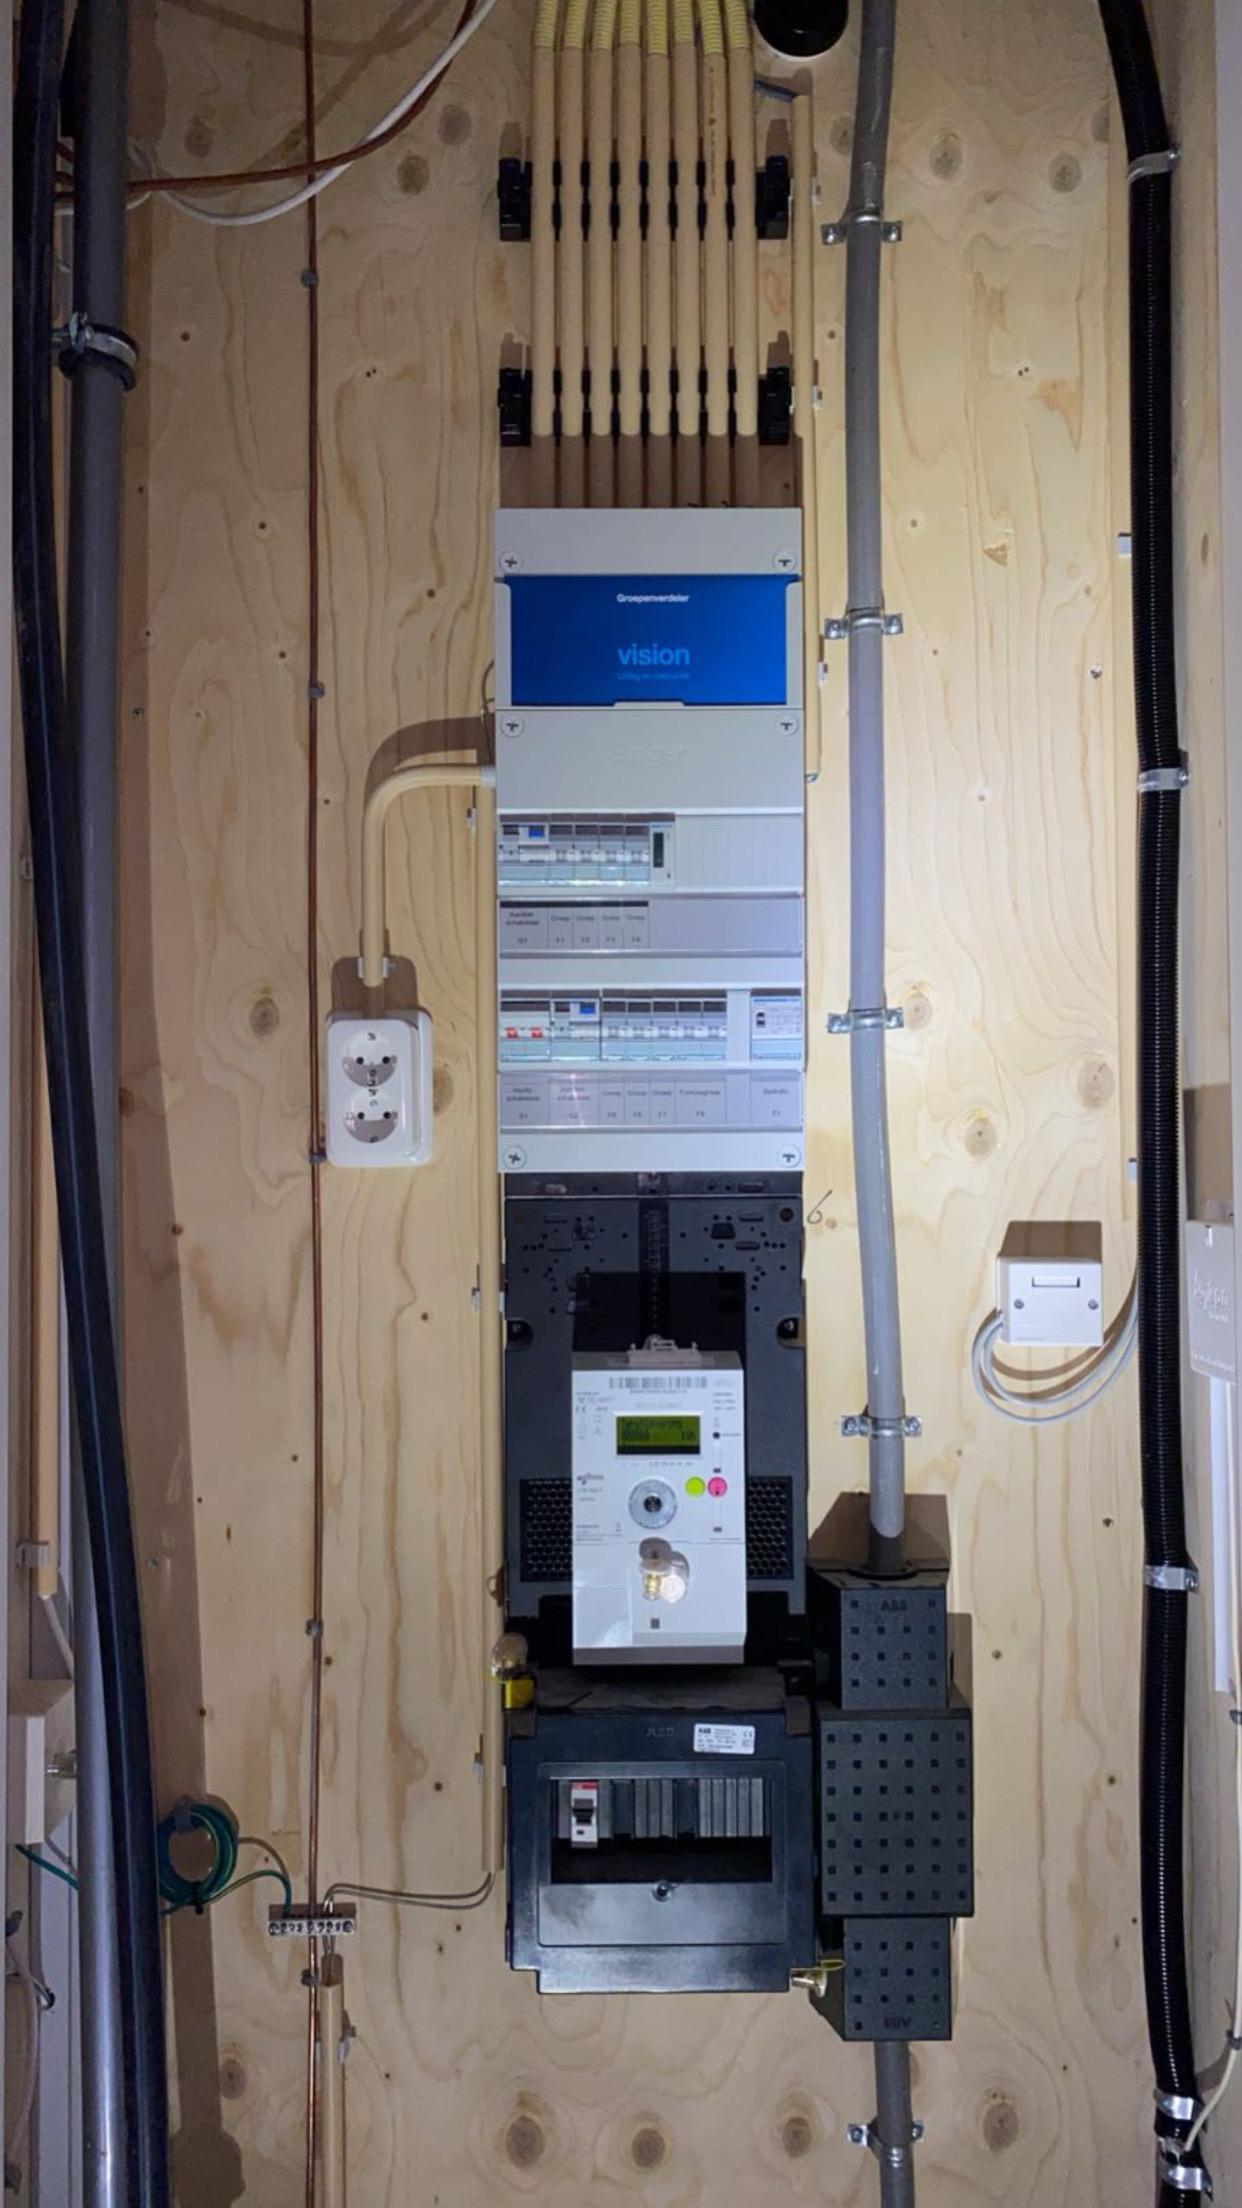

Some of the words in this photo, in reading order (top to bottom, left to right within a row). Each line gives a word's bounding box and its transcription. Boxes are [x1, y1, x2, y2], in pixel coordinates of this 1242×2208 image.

[617, 593, 690, 603] Groepenverdeler
[617, 643, 691, 666] vision
[880, 1599, 908, 1611] ABB
